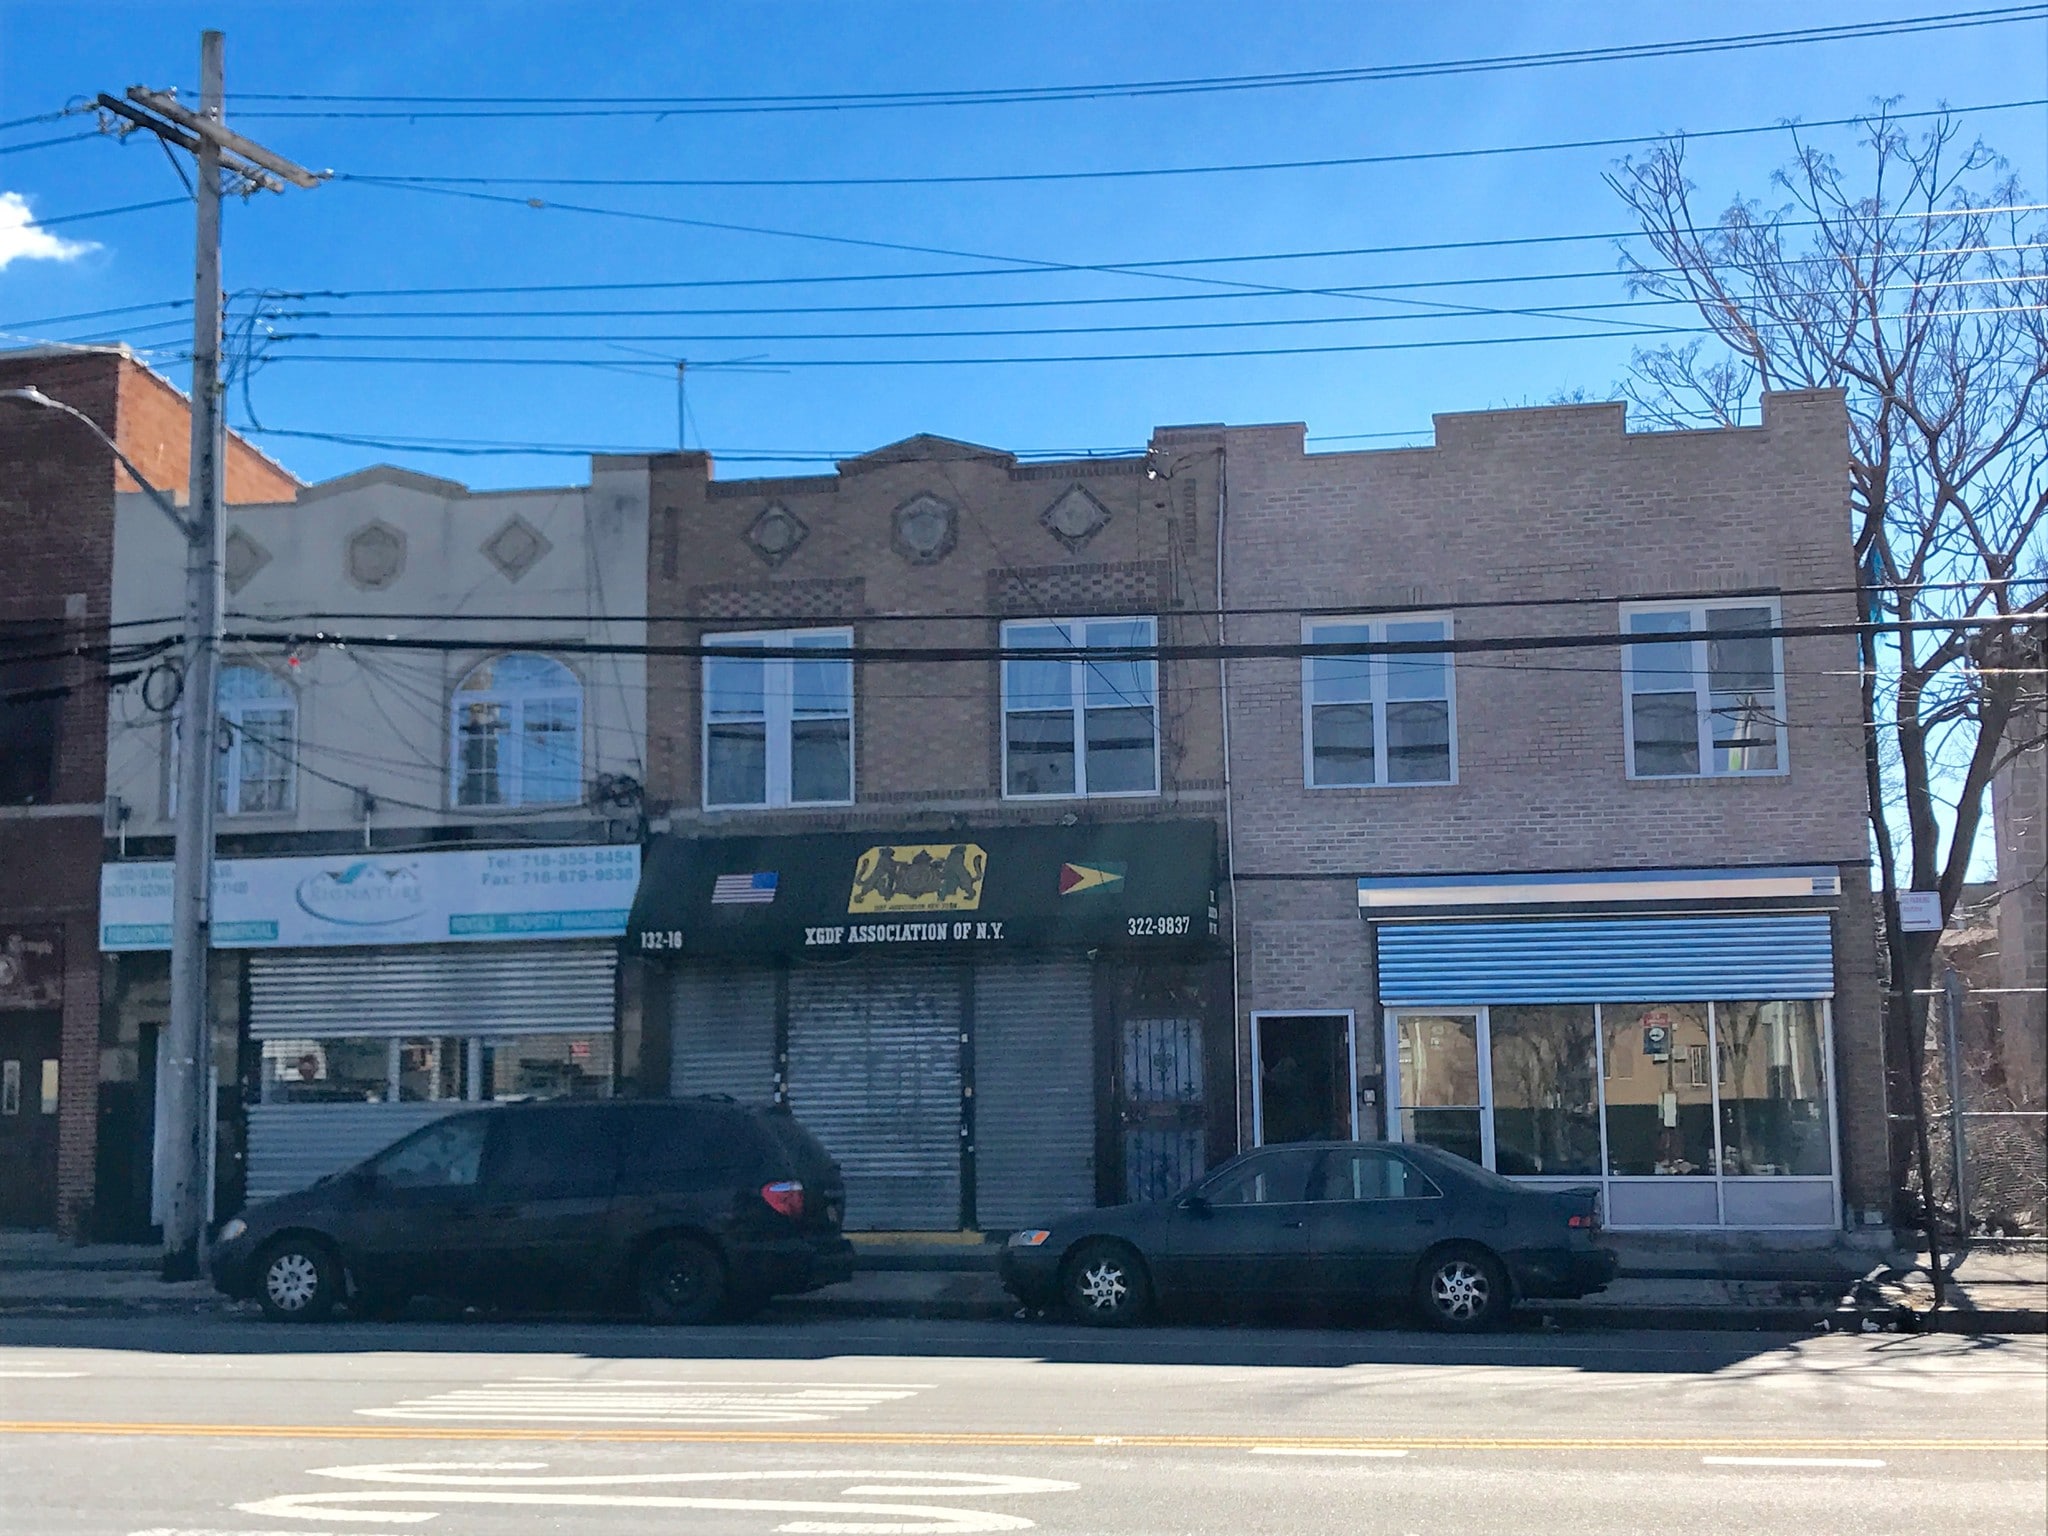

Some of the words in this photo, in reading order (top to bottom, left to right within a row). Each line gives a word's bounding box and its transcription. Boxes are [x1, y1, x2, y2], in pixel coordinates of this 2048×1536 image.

[521, 850, 633, 867] 718-355-8454
[805, 927, 844, 945] XGDF
[848, 923, 948, 943] ASSOCIATION
[953, 922, 971, 940] OF
[976, 922, 1004, 940] N.Y.
[1128, 916, 1190, 936] 322-9837
[641, 931, 682, 949] 132-16
